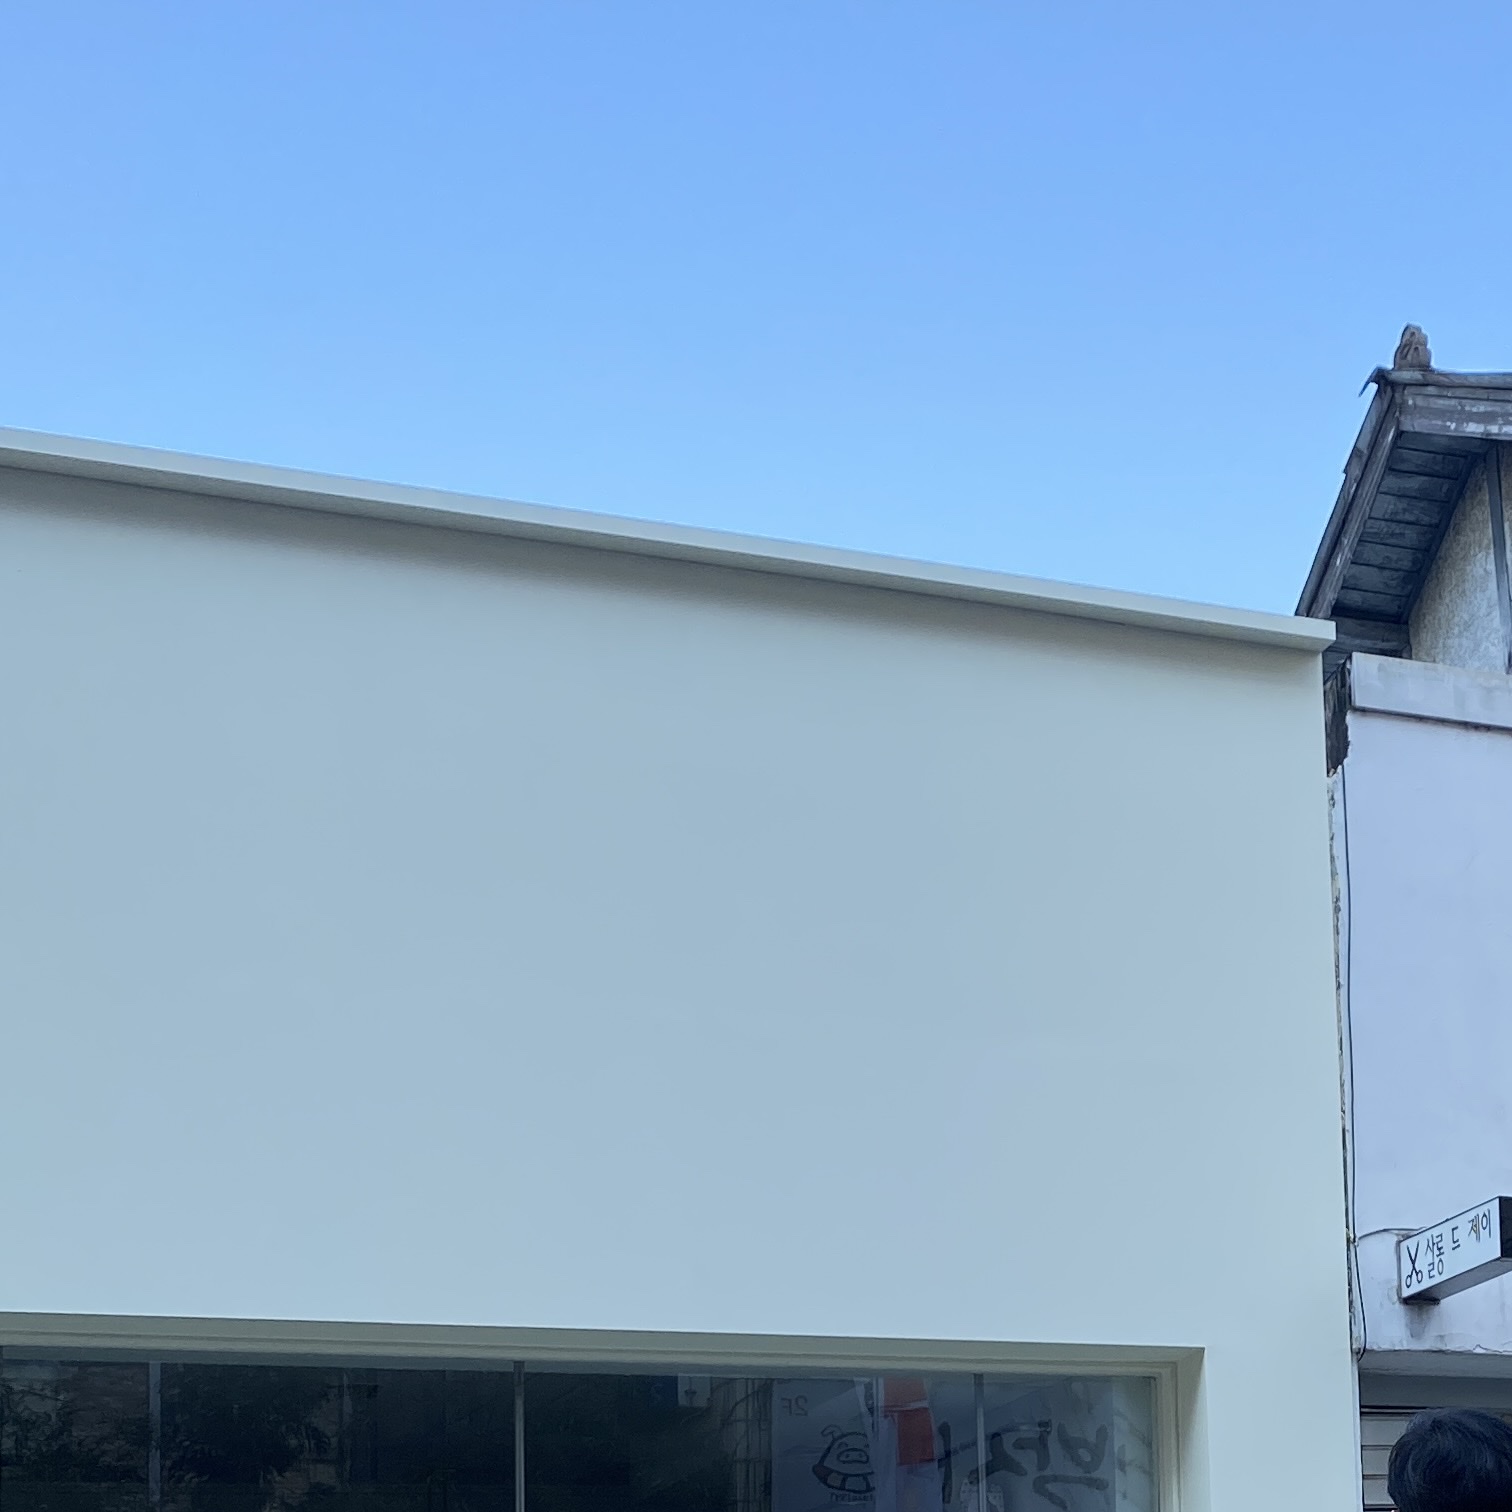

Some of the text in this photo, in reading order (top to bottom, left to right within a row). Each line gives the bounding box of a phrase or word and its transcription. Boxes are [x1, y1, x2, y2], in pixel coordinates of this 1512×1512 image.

[1424, 1209, 1492, 1279] 살롱 드 제이
